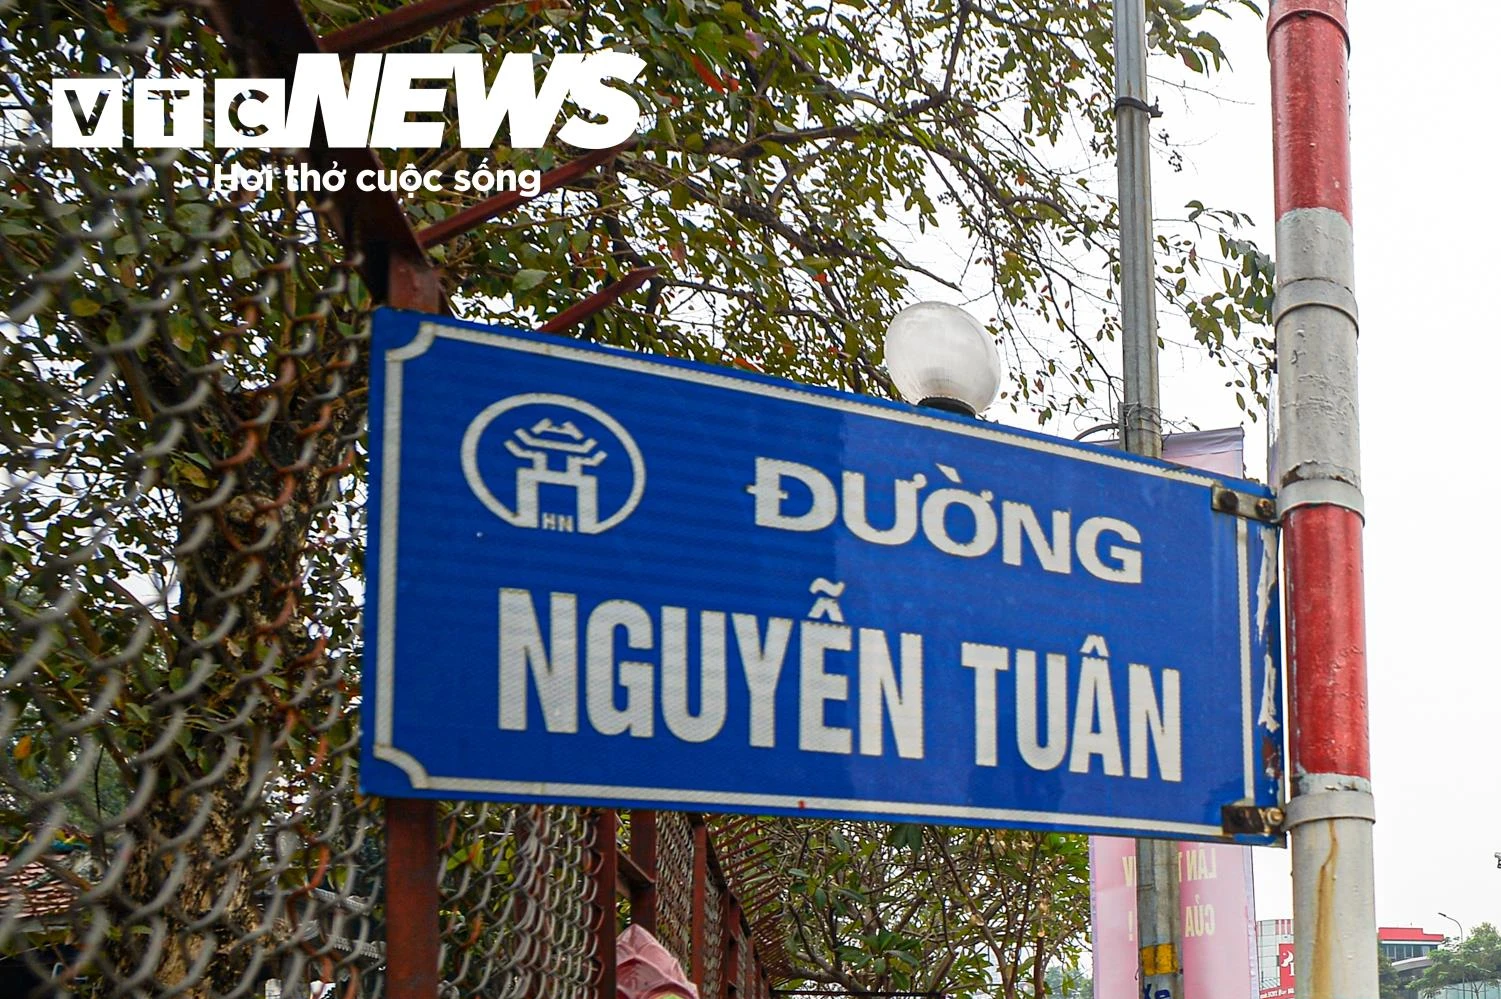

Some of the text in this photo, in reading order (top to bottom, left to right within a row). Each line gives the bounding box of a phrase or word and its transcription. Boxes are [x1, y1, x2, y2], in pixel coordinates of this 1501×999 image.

[541, 511, 574, 532] HN
[746, 456, 1143, 584] ĐƯỜNG
[498, 580, 1182, 782] NGUYỄN TUÂN
